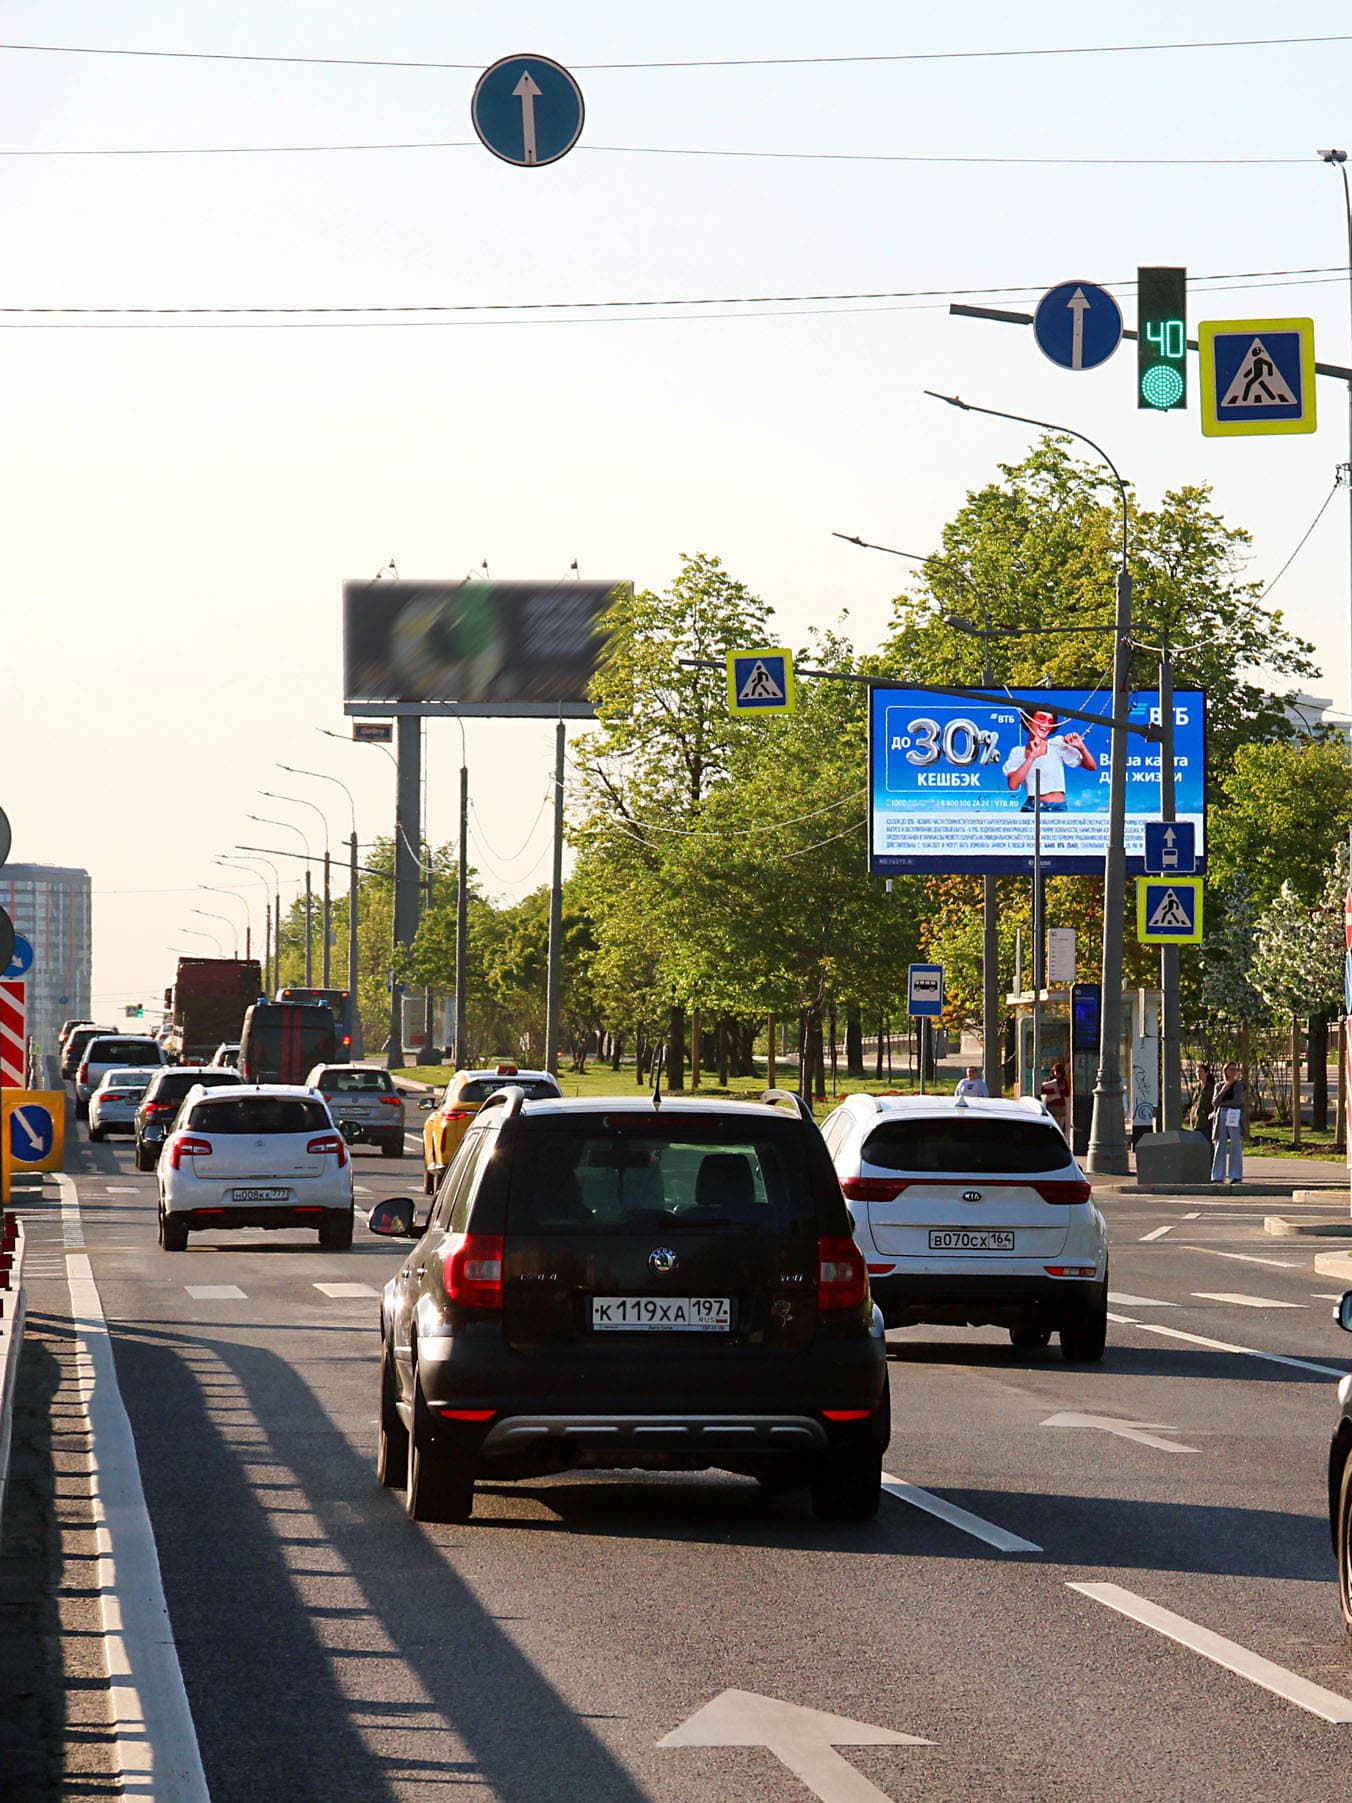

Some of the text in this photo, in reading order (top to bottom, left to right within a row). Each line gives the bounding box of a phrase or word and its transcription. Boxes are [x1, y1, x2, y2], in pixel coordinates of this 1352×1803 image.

[1146, 321, 1183, 357] 40
[998, 714, 1015, 723] ВТБ
[1150, 707, 1189, 725] ВБ
[891, 736, 911, 750] ДО
[917, 772, 981, 787] КЕШБЭК
[964, 1192, 980, 1200] KIA
